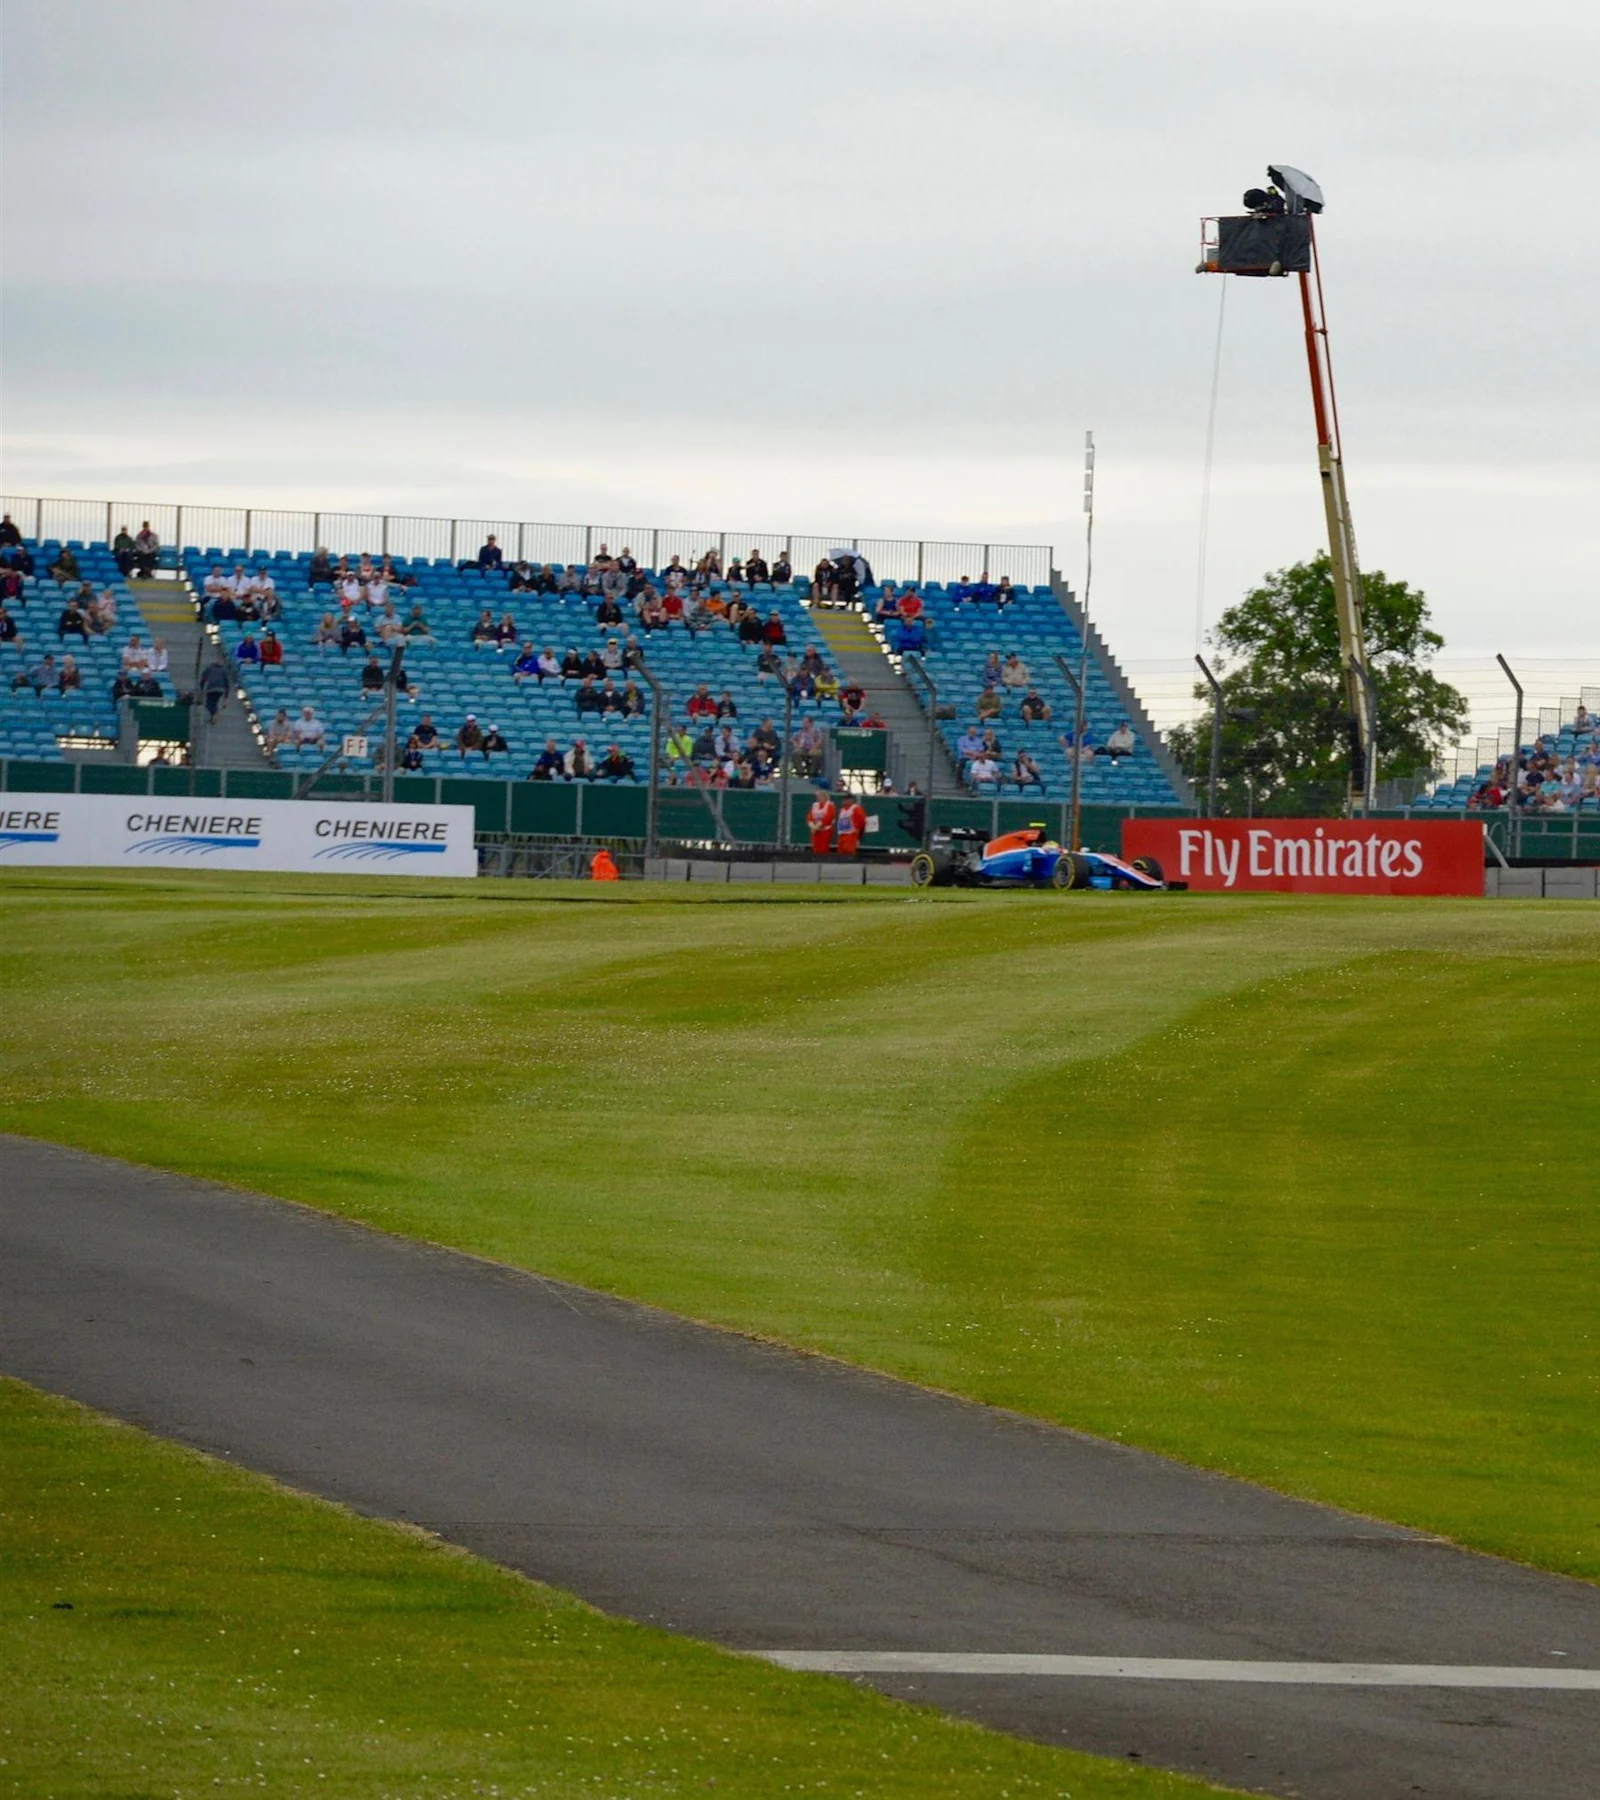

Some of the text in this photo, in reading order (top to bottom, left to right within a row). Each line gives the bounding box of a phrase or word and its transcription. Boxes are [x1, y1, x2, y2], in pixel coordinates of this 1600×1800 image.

[126, 814, 263, 835] CHENIERE
[315, 819, 449, 841] CHENIERE
[1178, 827, 1423, 887] Fly Emirates
